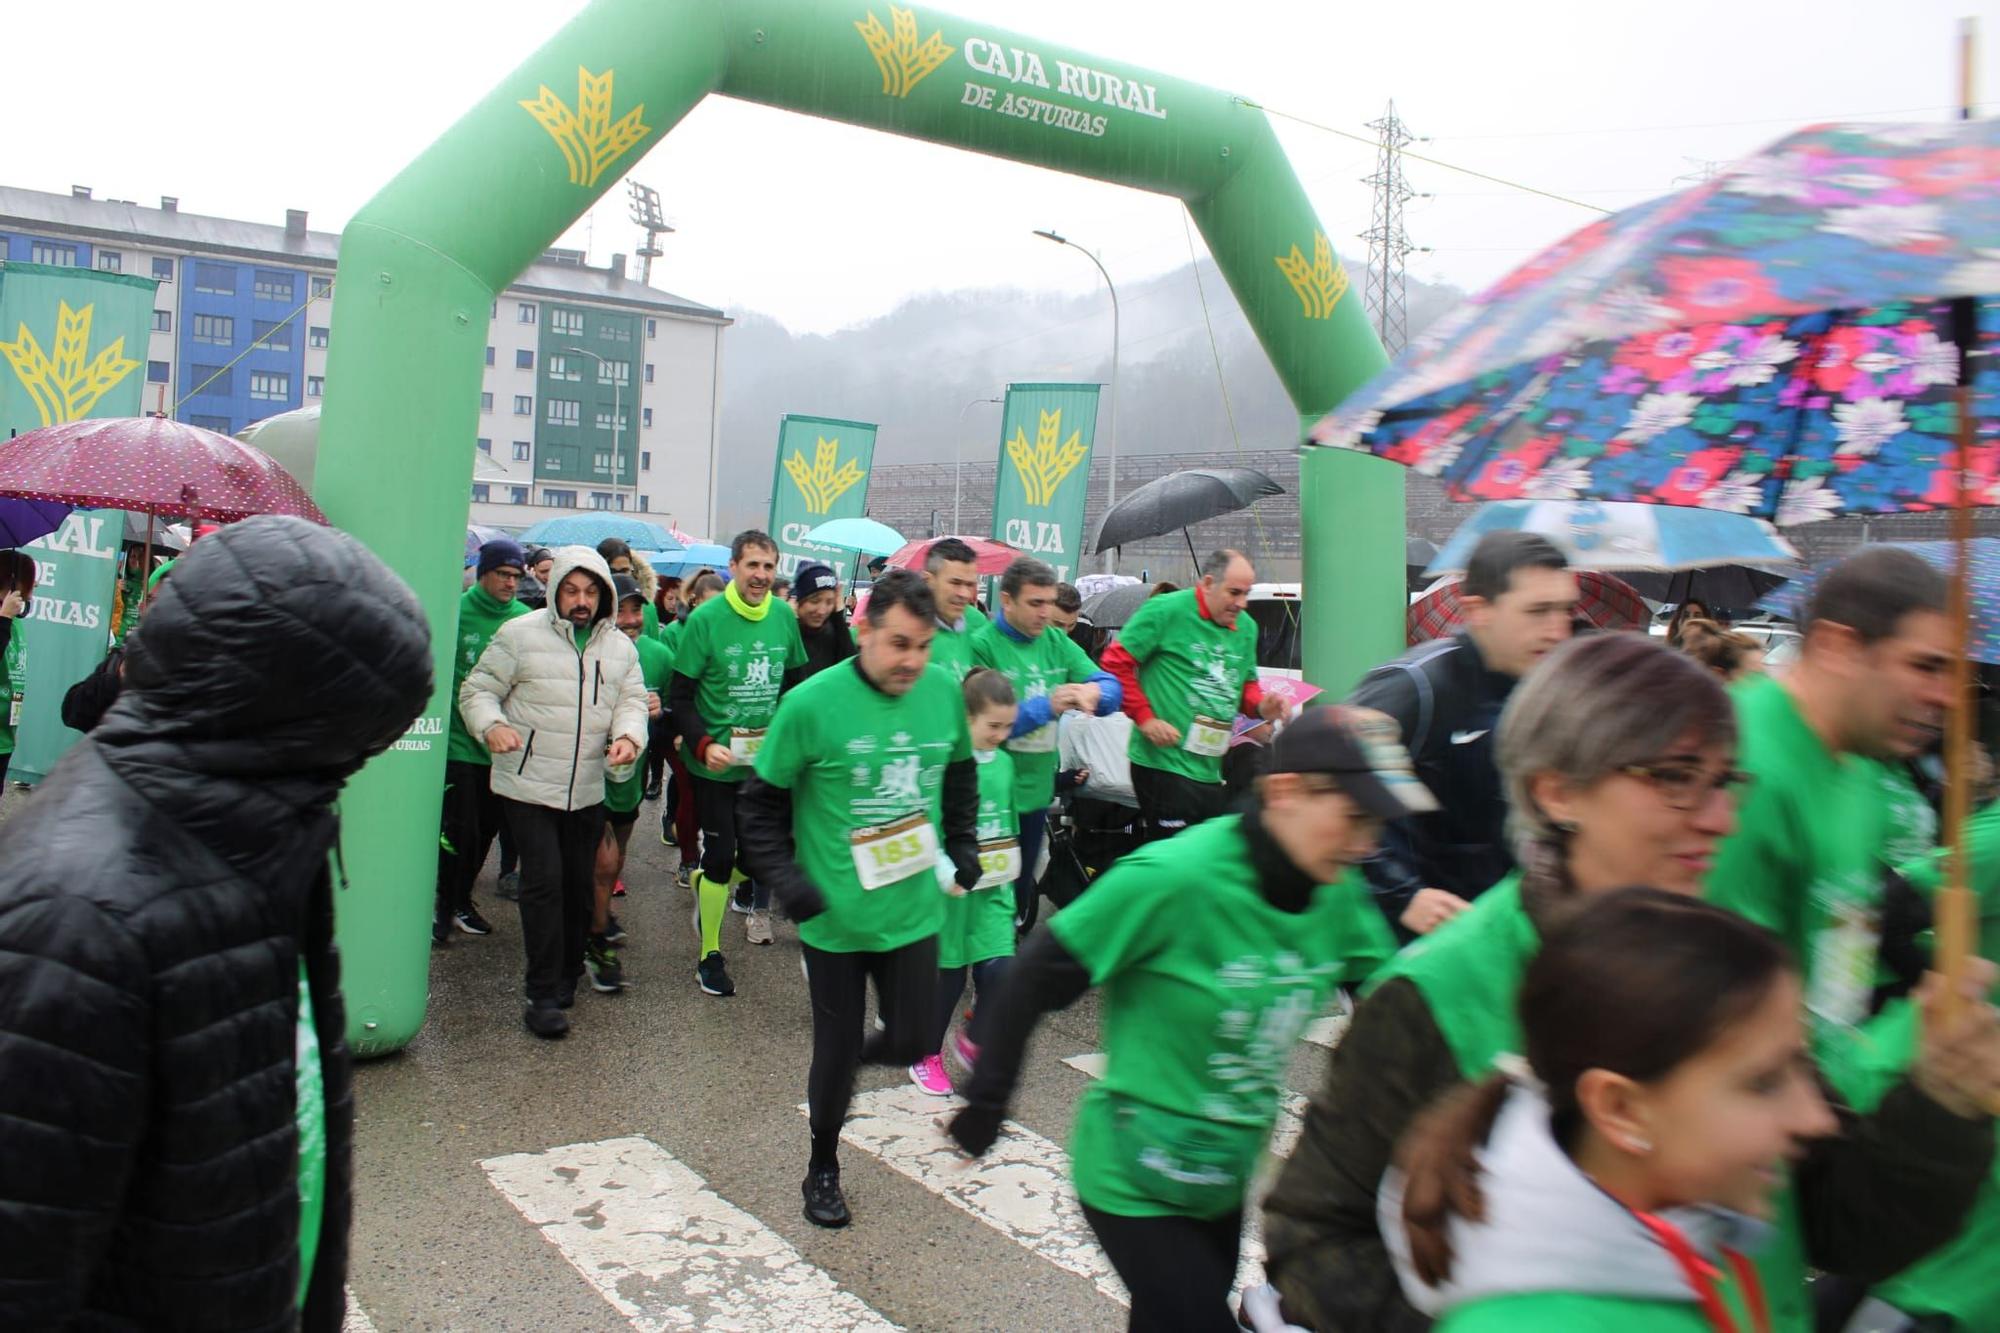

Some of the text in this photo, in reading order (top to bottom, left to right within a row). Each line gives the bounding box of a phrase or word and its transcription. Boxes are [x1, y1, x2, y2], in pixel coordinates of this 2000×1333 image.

[963, 37, 1167, 120] CAJA RURAL
[961, 82, 1108, 137] DE ASTURIAS
[1006, 518, 1065, 554] CAJA
[869, 832, 924, 868] 183
